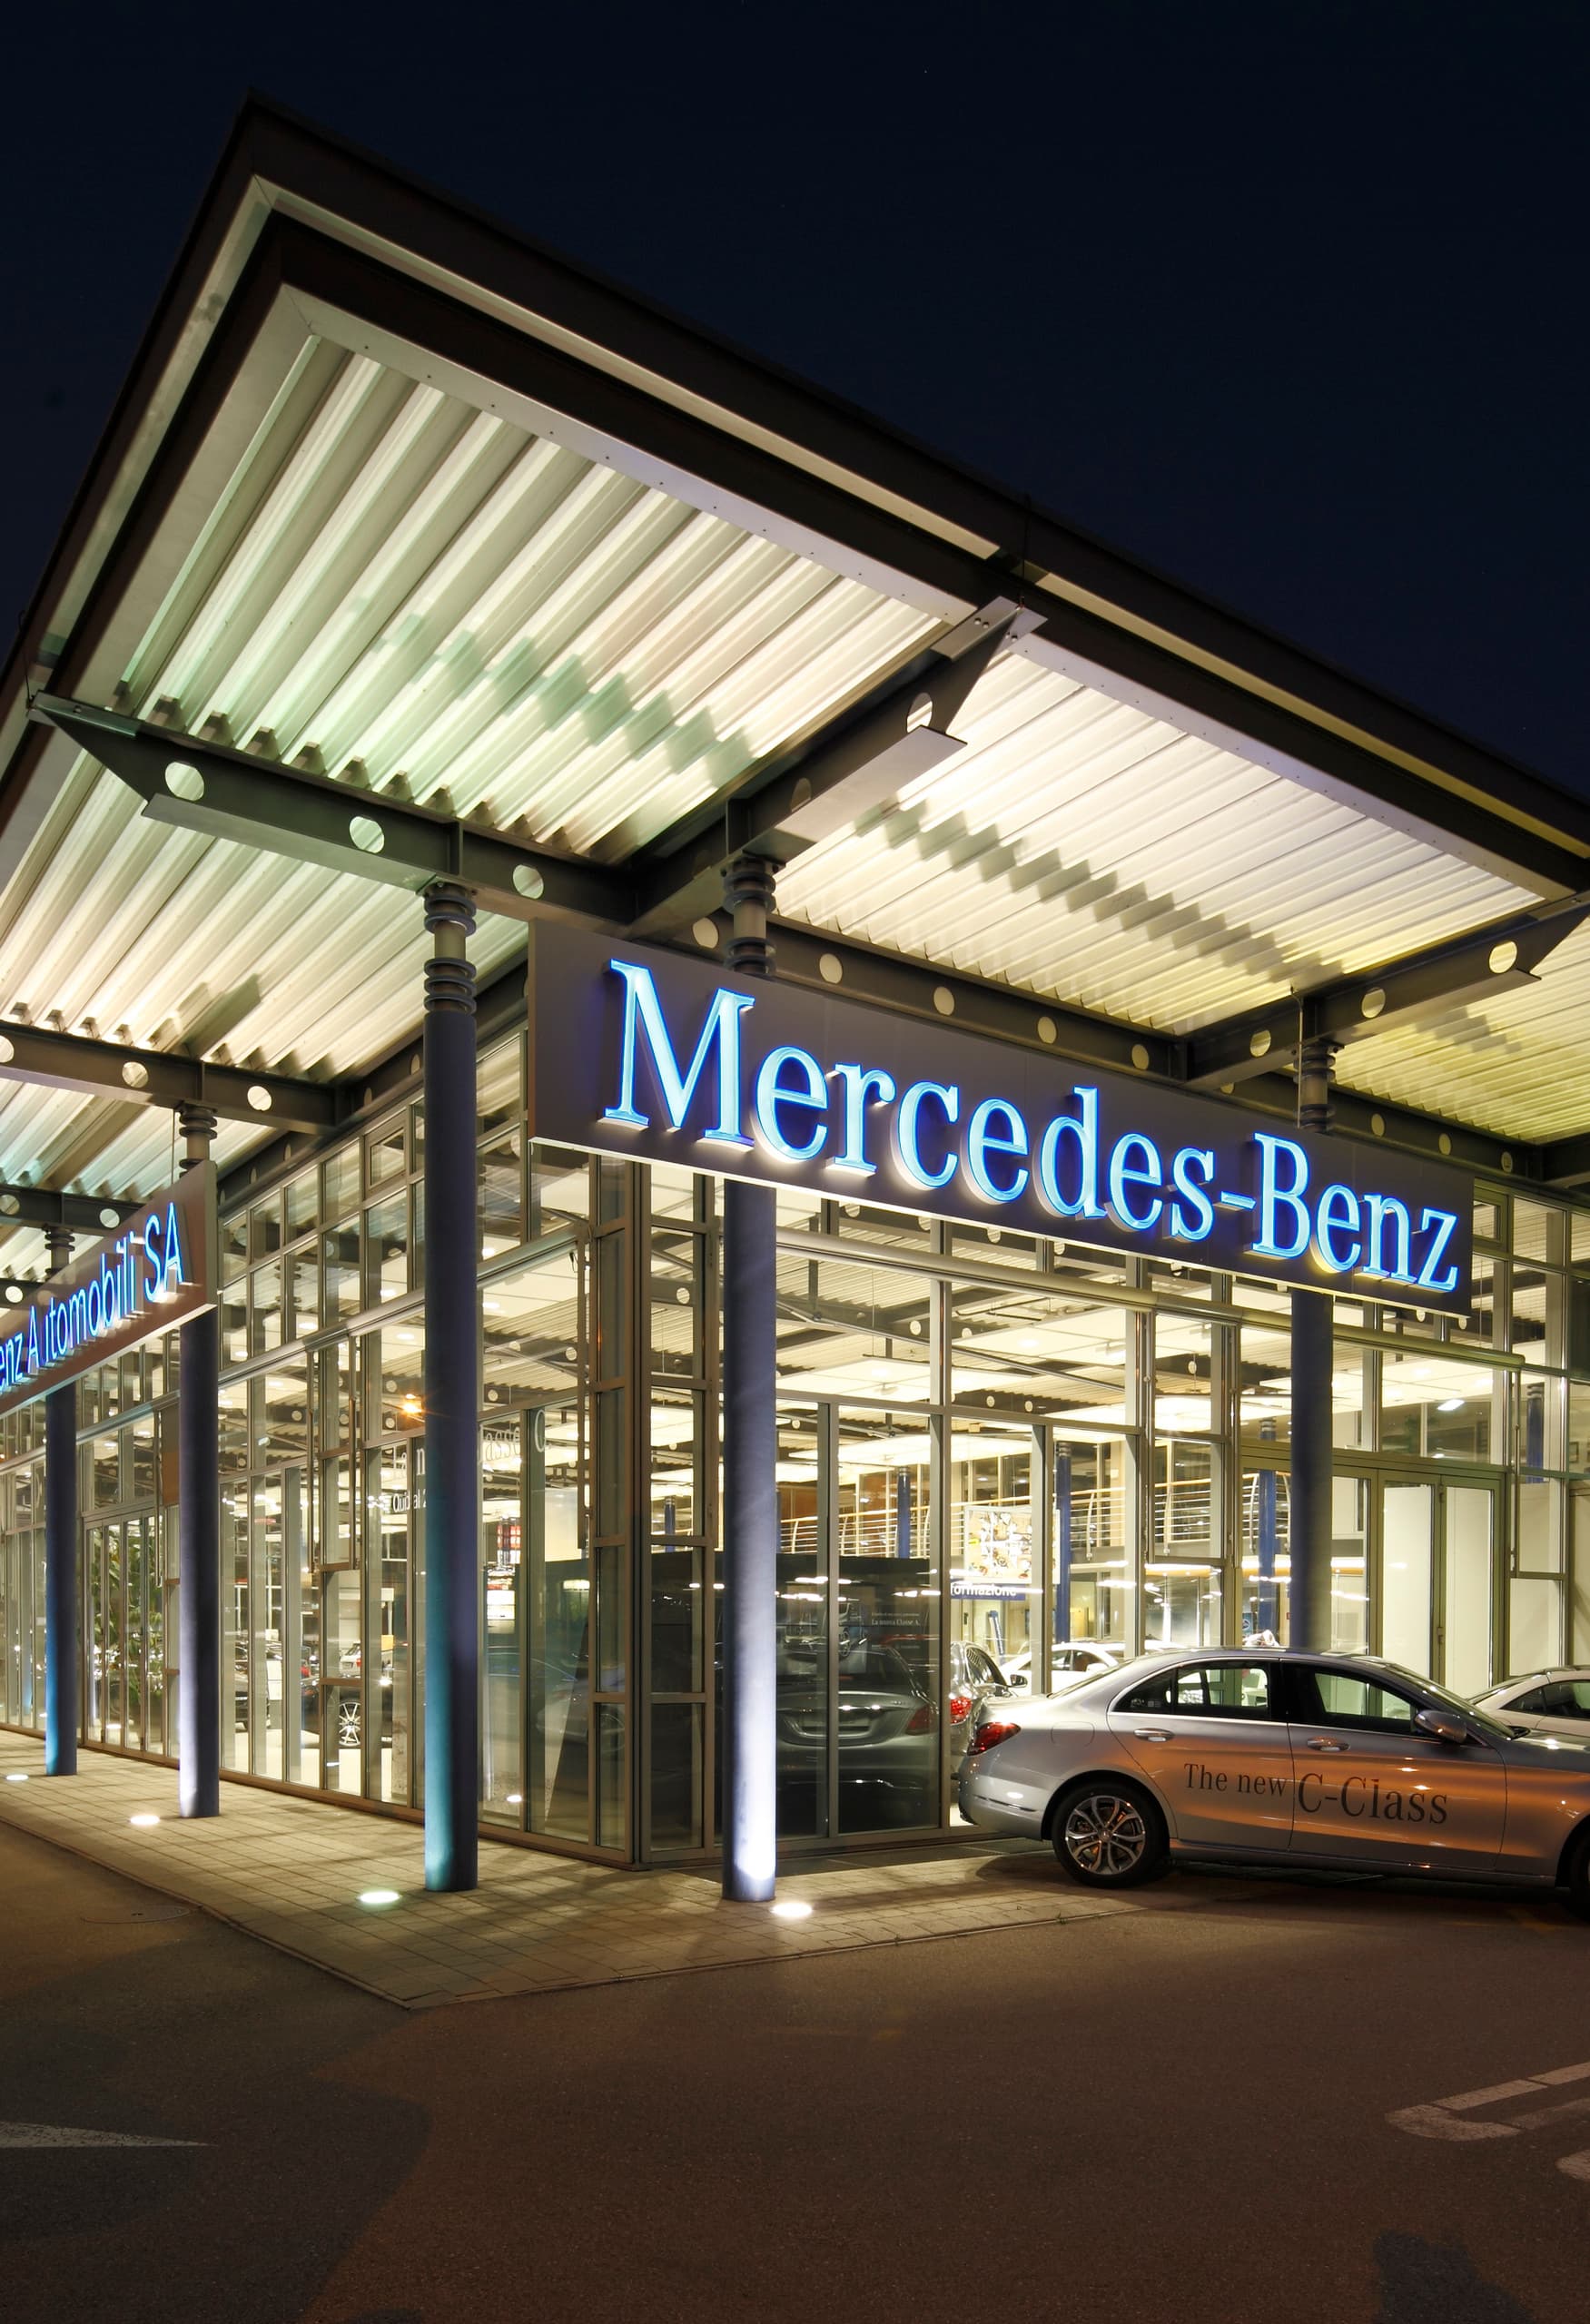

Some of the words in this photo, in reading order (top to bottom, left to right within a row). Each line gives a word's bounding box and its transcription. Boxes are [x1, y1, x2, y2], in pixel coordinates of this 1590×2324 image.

[604, 958, 1458, 1292] Mercedes-Benz
[27, 1231, 137, 1374] Automobili
[144, 1202, 183, 1303] SA
[1183, 1763, 1228, 1793] The
[1238, 1773, 1286, 1797] new
[1298, 1773, 1448, 1824] C-Class
